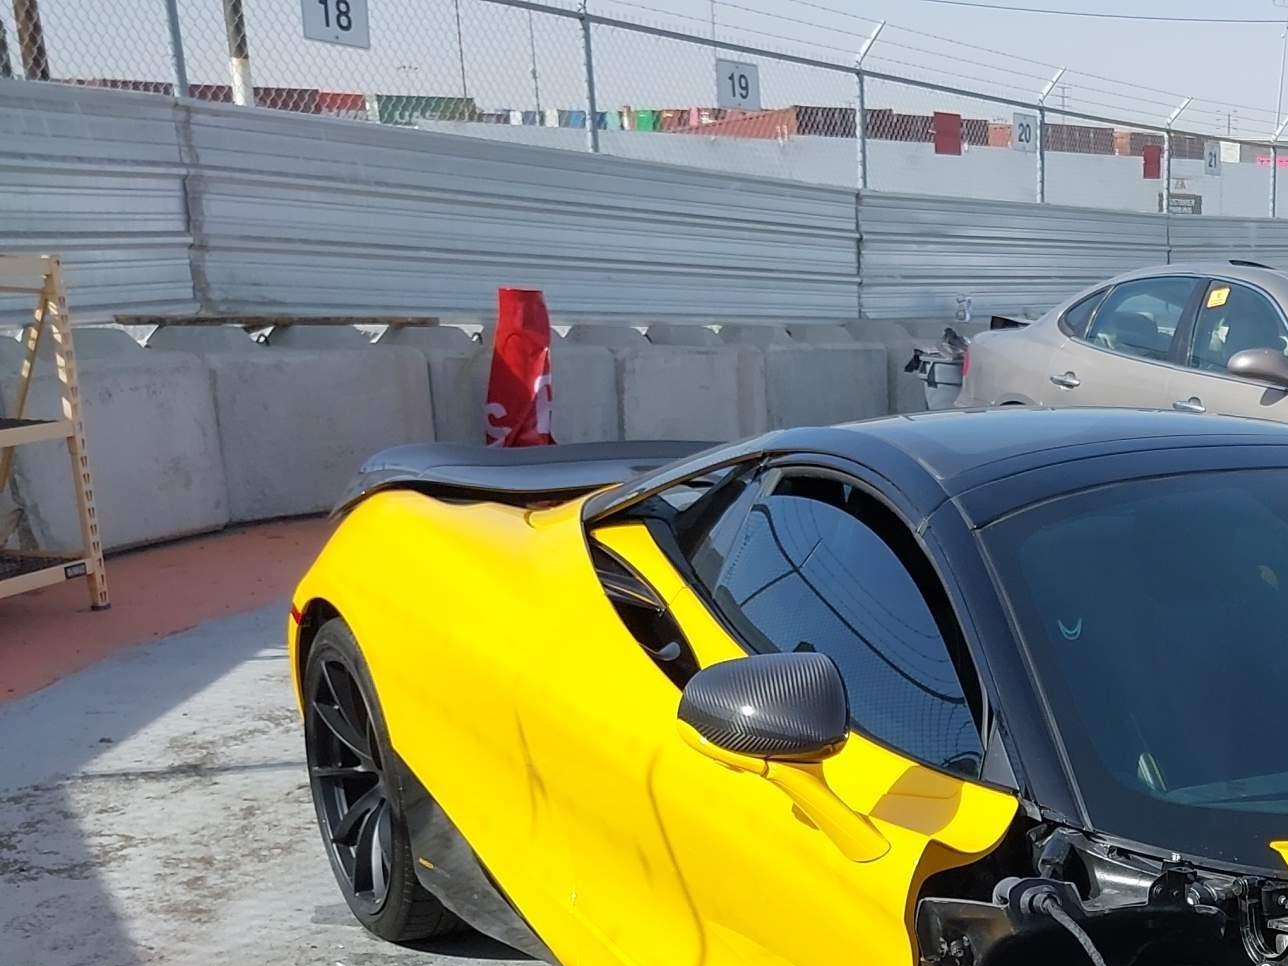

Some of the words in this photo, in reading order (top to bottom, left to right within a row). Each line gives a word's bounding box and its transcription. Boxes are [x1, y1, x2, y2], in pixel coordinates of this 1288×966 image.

[319, 0, 352, 31] 18
[728, 72, 749, 99] 19
[1018, 122, 1032, 143] 20
[1208, 151, 1217, 169] 21
